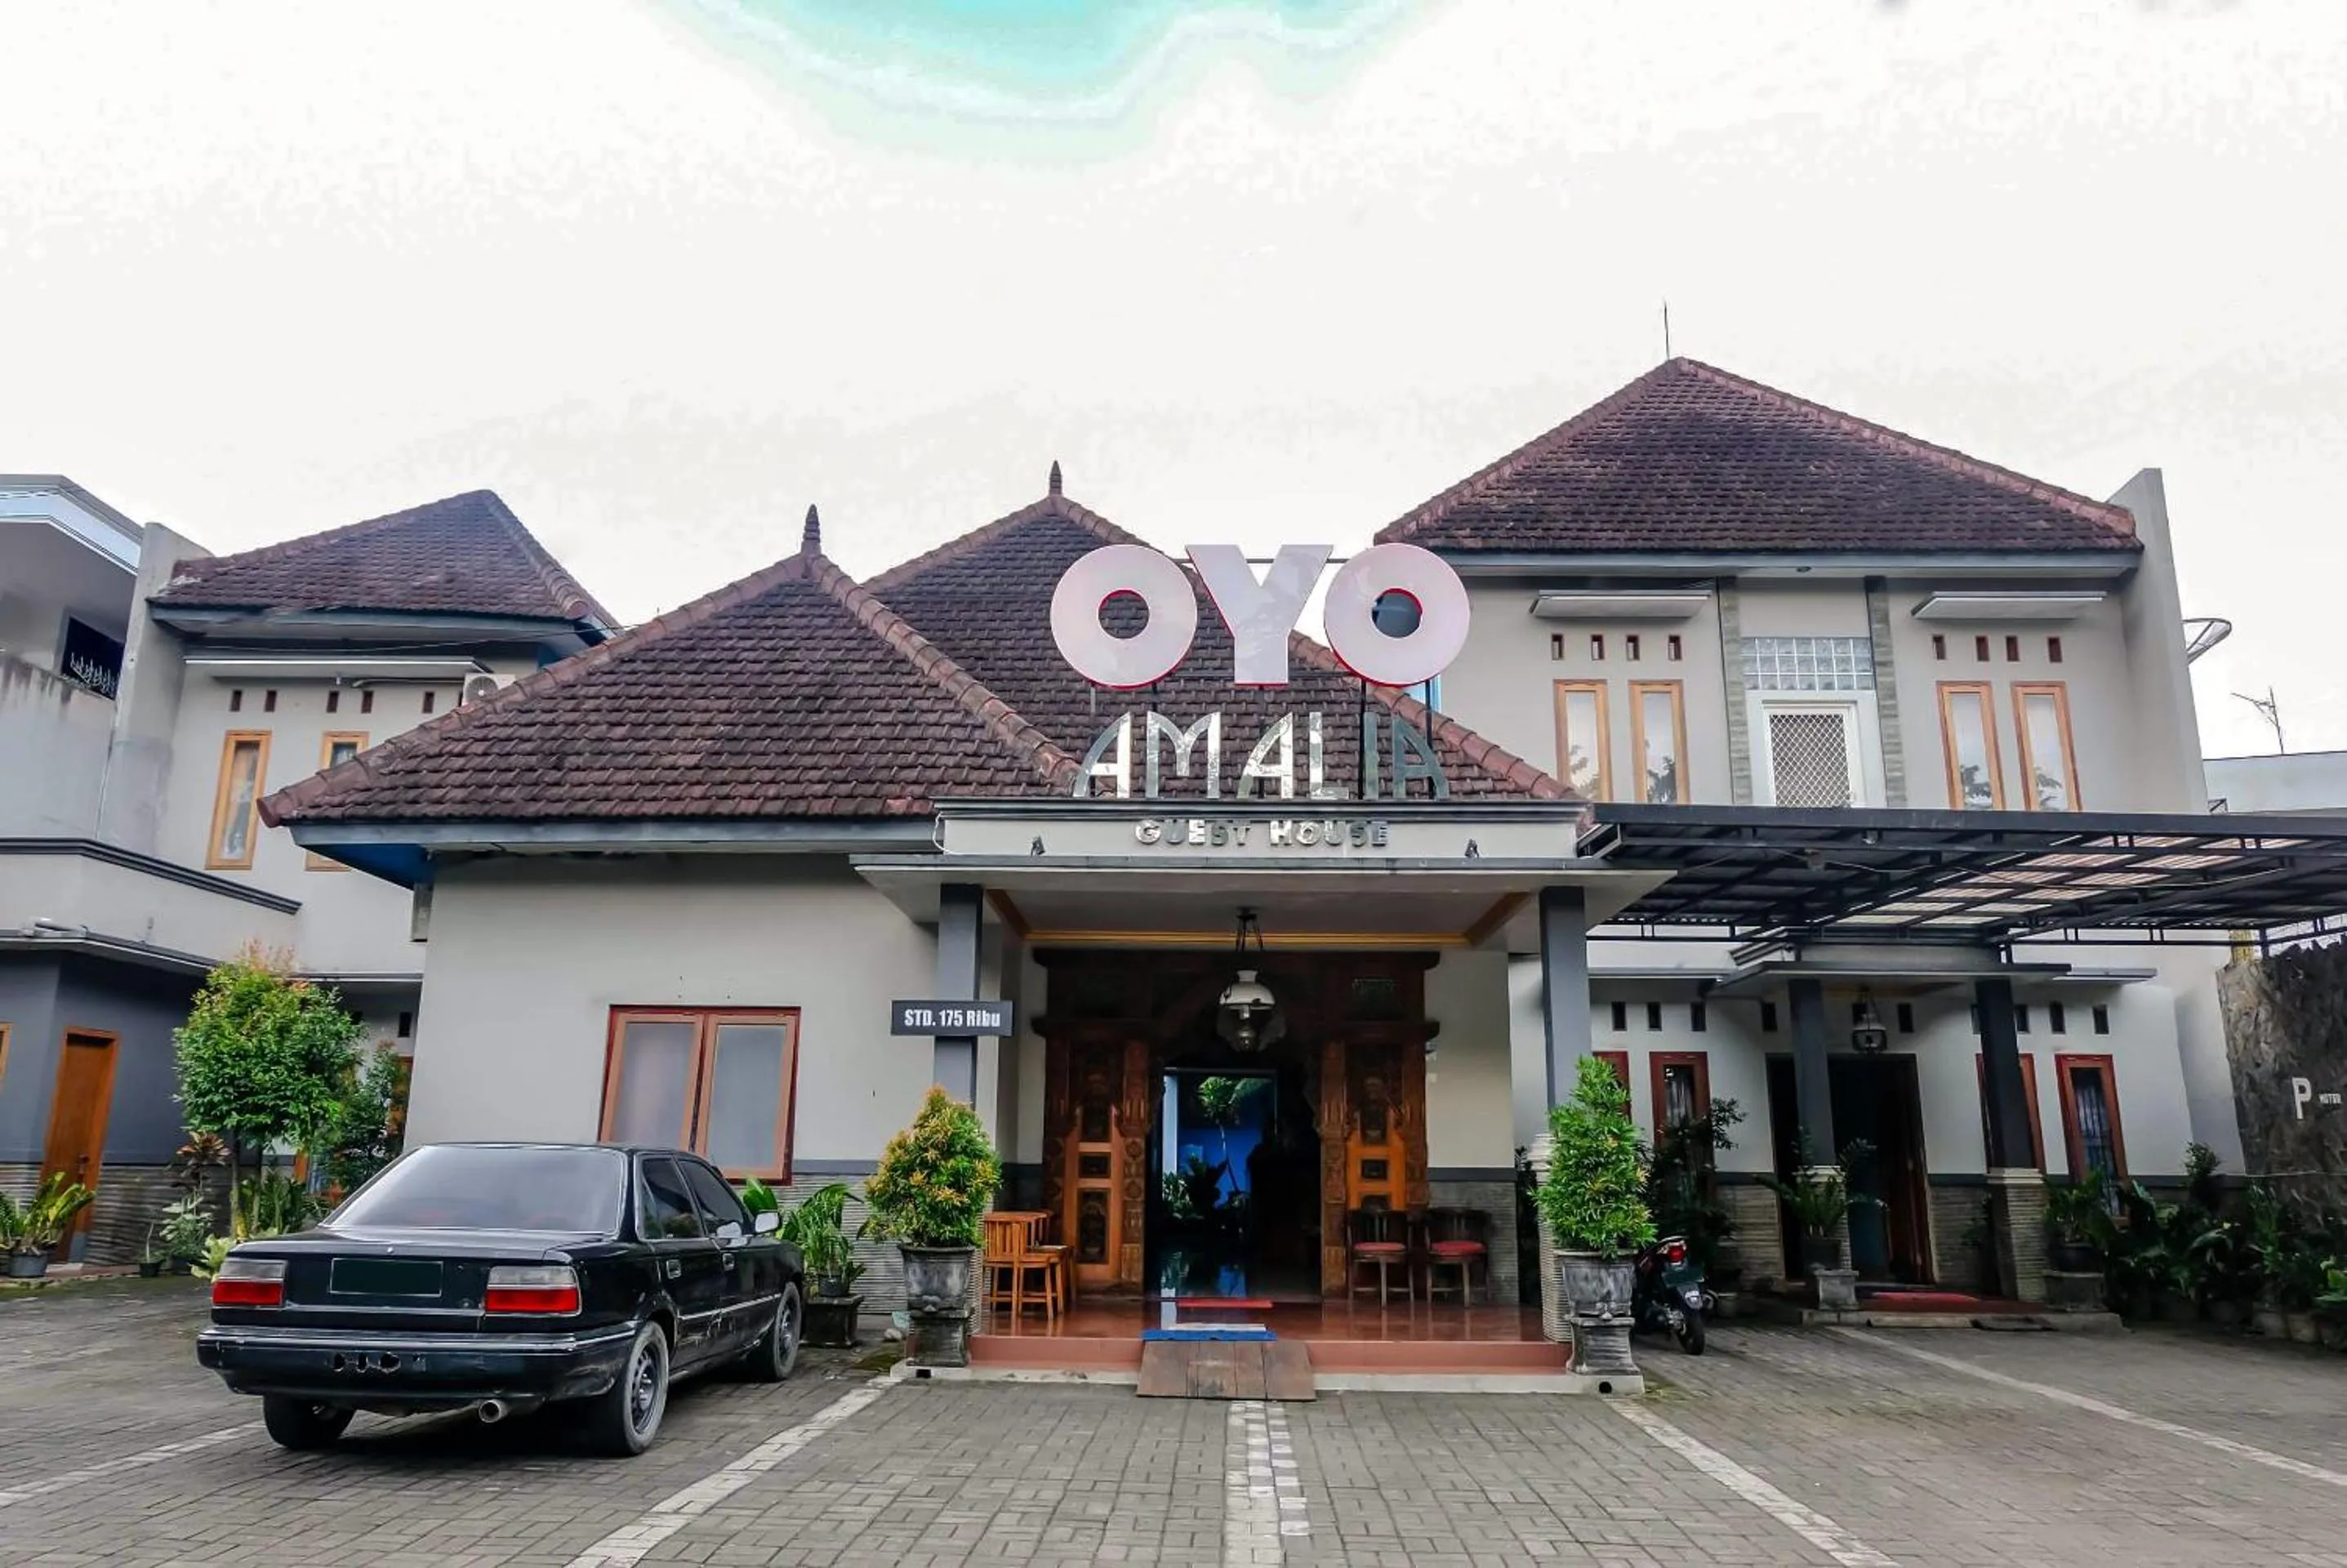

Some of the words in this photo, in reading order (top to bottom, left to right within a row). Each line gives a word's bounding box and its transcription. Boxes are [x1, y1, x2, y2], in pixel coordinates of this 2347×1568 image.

[1050, 543, 1470, 688] OYO
[1072, 711, 1450, 800] AMALIA
[1134, 819, 1251, 846] GUEST
[1270, 820, 1388, 847] HOUSE
[904, 1009, 937, 1027] STD.
[939, 1009, 964, 1027] 175
[966, 1010, 1000, 1027] Ribu
[2291, 1076, 2312, 1120] P
